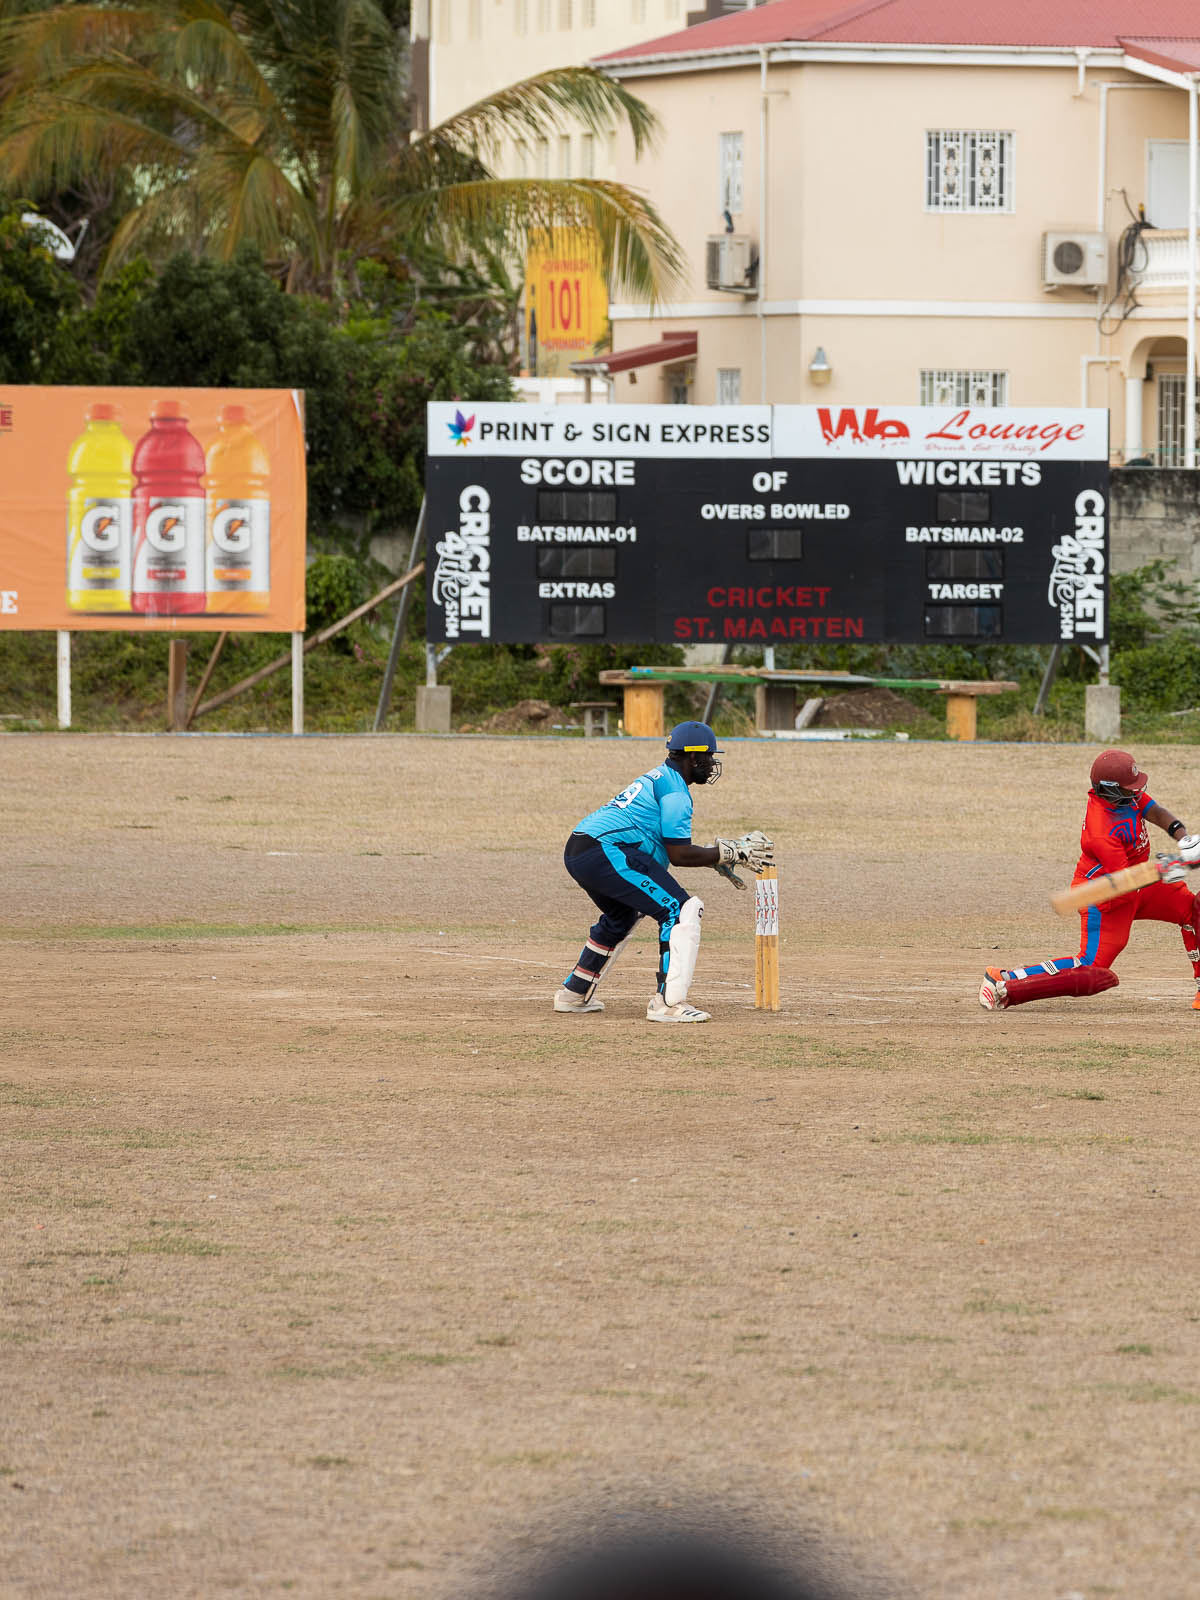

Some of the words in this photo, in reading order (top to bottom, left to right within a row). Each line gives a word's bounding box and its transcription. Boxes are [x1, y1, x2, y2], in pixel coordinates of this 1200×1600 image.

[549, 279, 582, 331] 101
[480, 422, 554, 441] PRINT
[564, 423, 583, 441] &
[593, 424, 650, 442] SIGN
[661, 424, 769, 443] EXPRESS
[925, 410, 1085, 450] Lounge
[521, 459, 635, 485] SCORE
[753, 472, 788, 493] OF
[897, 462, 1041, 486] WICKETS
[701, 504, 766, 520] OVERS
[771, 504, 850, 520] BOWLED
[81, 506, 120, 551] G
[146, 506, 186, 552] G
[213, 506, 250, 552] G
[517, 526, 636, 542] BATSMAN-01
[906, 528, 1023, 543] BATSMAN-02
[460, 485, 490, 637] CRICKET
[1075, 489, 1105, 639] CRICKET
[539, 583, 615, 598] EXTRAS
[707, 587, 830, 608] CRICKET
[929, 584, 1003, 599] TARGET
[674, 618, 715, 638] ST.
[724, 618, 863, 638] MAARTEN
